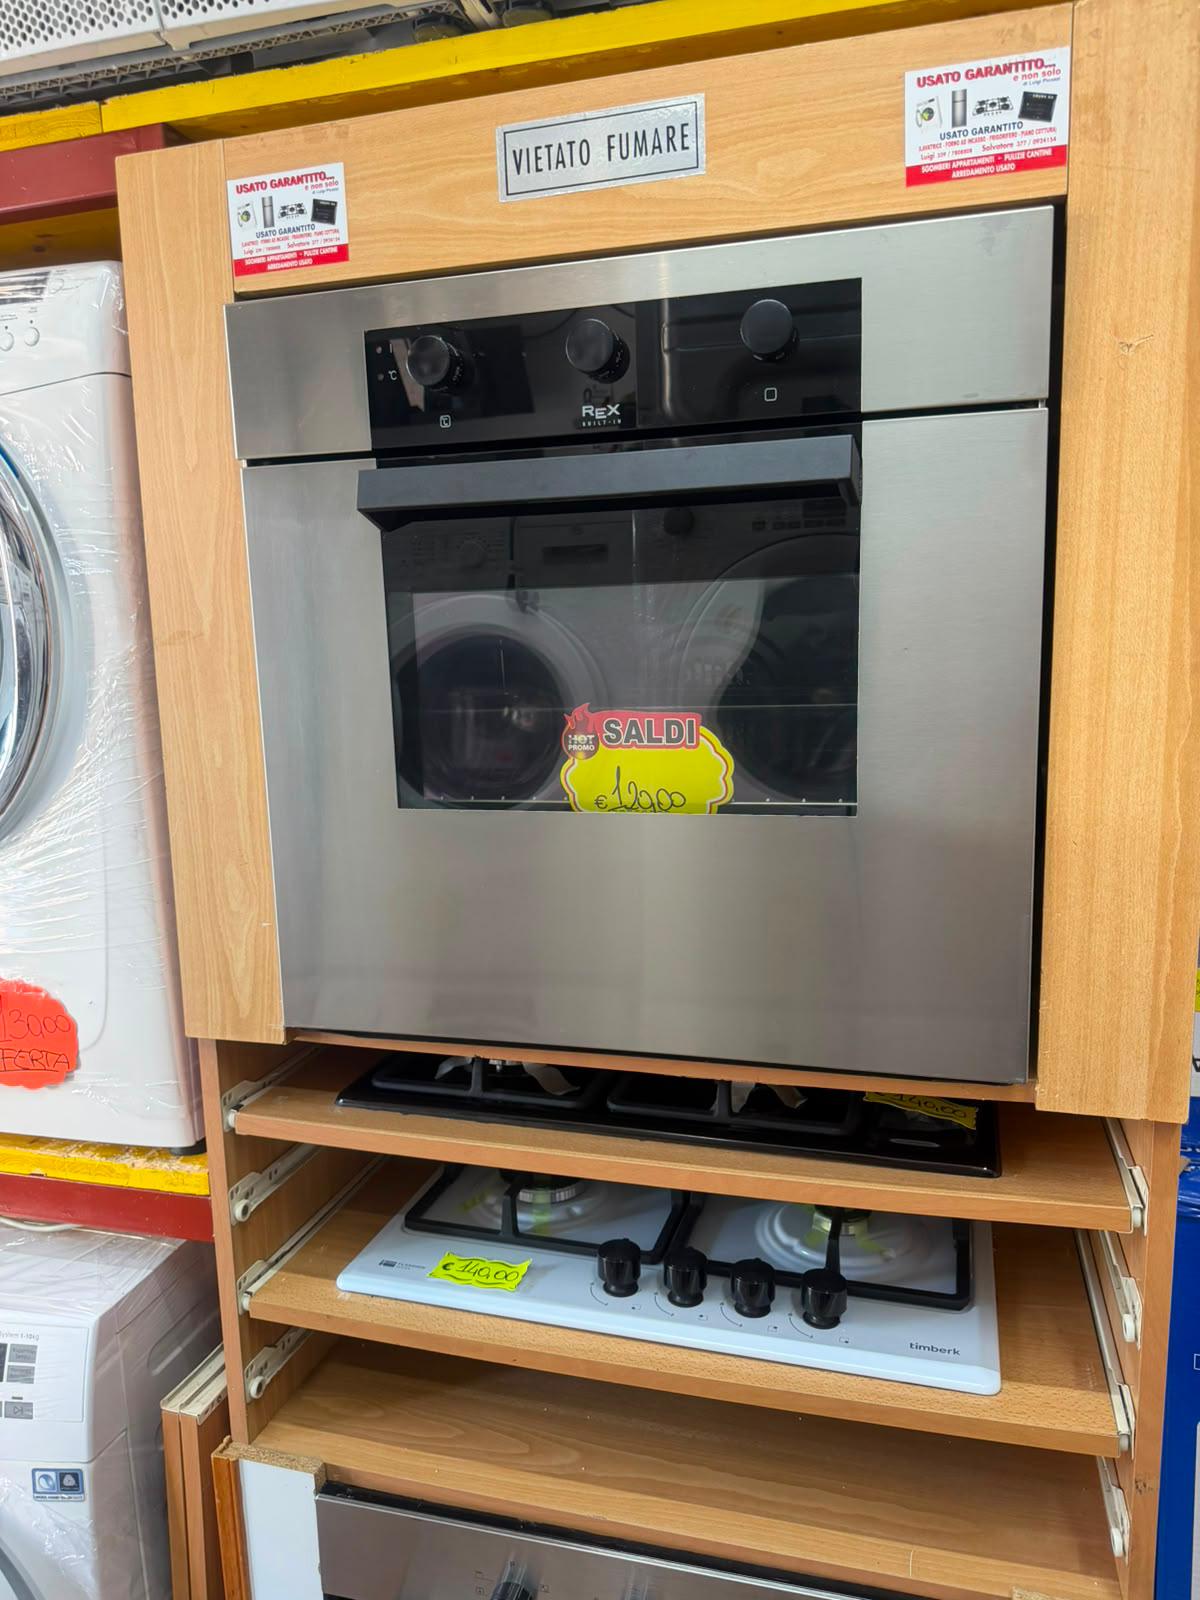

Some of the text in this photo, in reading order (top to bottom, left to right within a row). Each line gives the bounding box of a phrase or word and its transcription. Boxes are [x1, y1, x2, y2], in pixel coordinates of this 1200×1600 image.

[917, 71, 961, 88] USATO
[965, 58, 1056, 80] GARANTITO...
[1013, 74, 1019, 82] e
[1021, 70, 1039, 80] non
[1041, 67, 1061, 78] solo
[940, 121, 1023, 140] USATO GARANTITO
[512, 122, 690, 176] VIETATO FUMARE
[982, 142, 1013, 152] Salvatore
[951, 163, 1016, 178] ARREDAMENTO USATO
[235, 181, 268, 194] USATO
[311, 183, 323, 191] non
[325, 180, 339, 188] solo
[256, 229, 277, 238] USATO
[279, 223, 315, 235] GARANTITO
[582, 403, 621, 420] REX
[568, 734, 595, 745] HOT
[603, 718, 696, 746] SALDI
[909, 1342, 960, 1356] timberk
